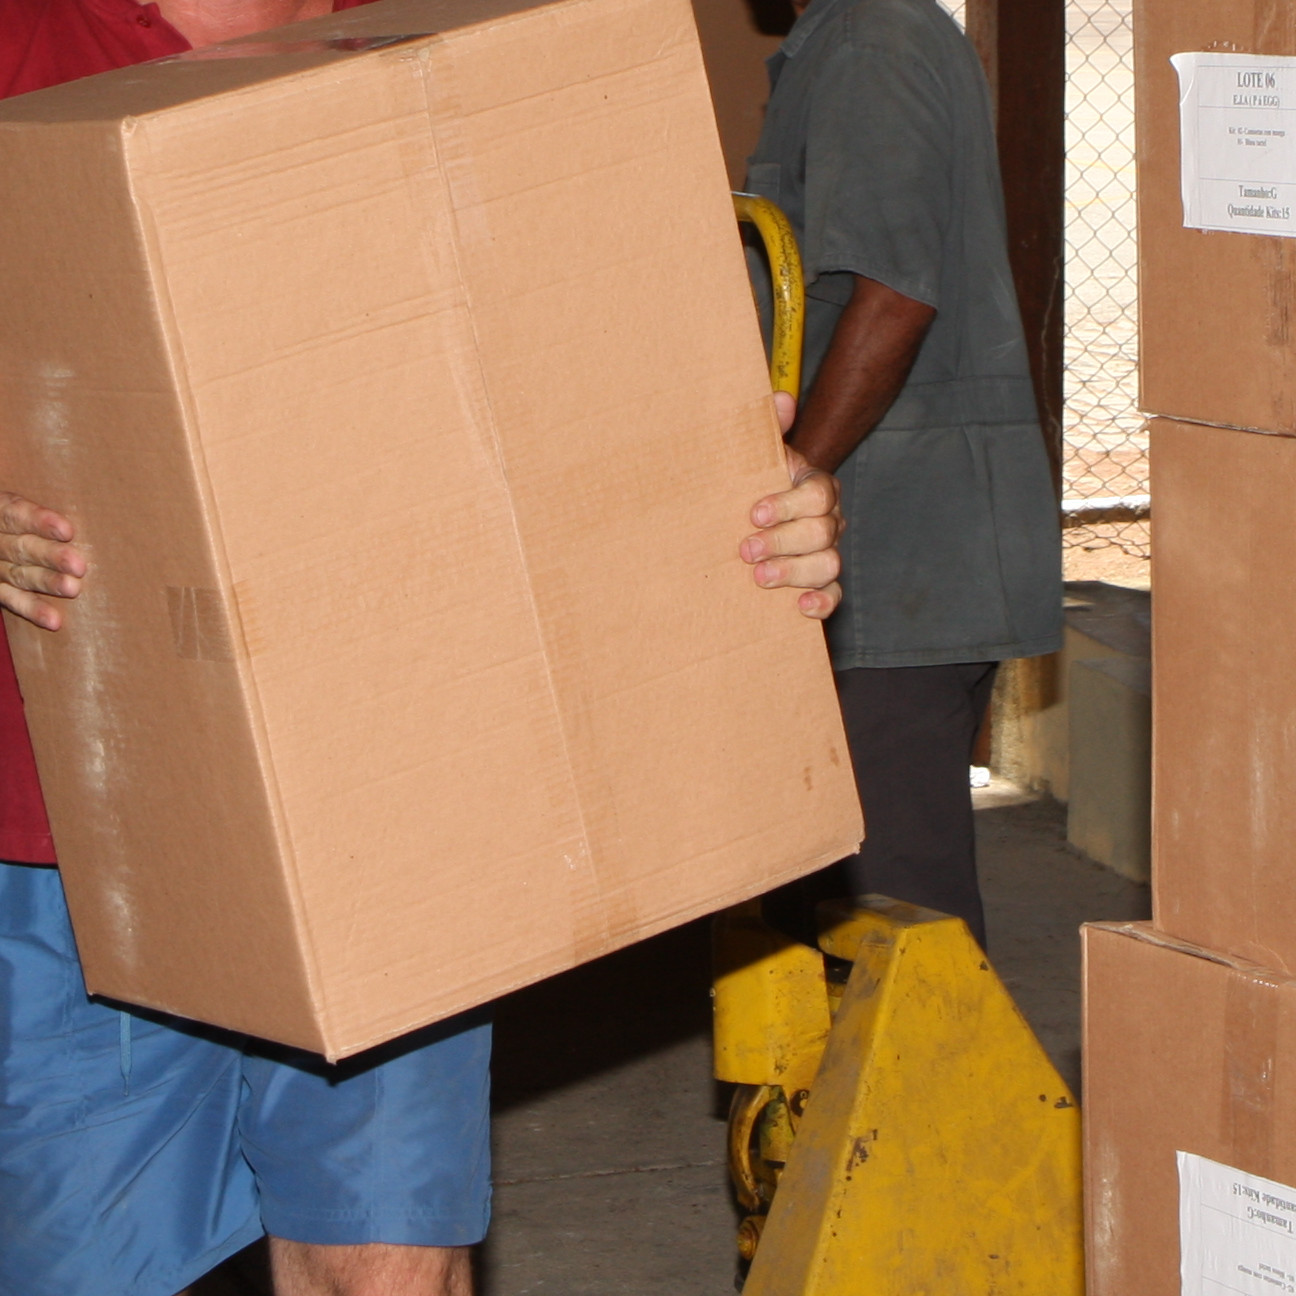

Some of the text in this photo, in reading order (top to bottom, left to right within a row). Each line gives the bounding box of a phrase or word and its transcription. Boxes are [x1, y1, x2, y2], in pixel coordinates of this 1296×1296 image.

[1237, 72, 1276, 88] LOTE 06
[1227, 203, 1264, 219] Quantidade
